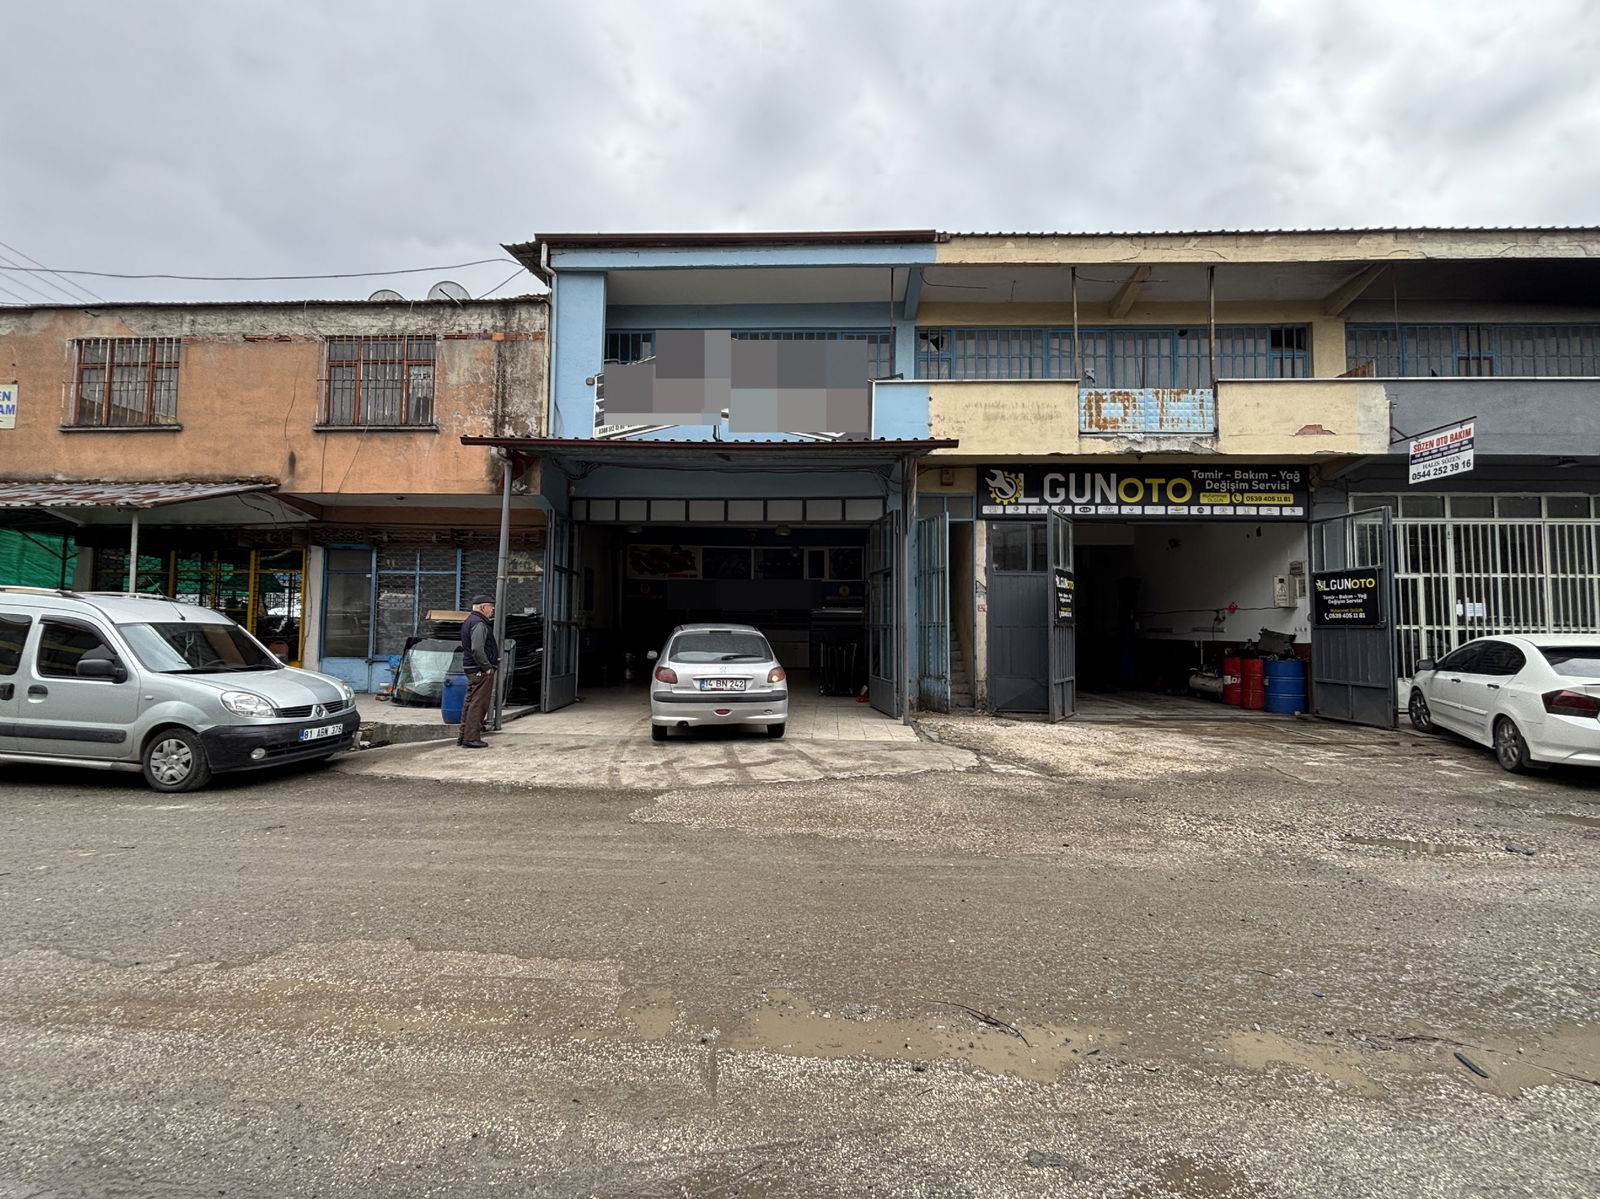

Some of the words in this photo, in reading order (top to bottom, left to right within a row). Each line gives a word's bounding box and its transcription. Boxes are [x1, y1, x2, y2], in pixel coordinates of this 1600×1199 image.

[1436, 435, 1448, 446] OTO
[1450, 428, 1472, 442] BAKIM
[1412, 470, 1431, 480] 0544
[1433, 466, 1448, 476] 252
[1450, 462, 1460, 472] 39
[1462, 458, 1472, 468] 16
[1192, 470, 1223, 480] Tamir
[1234, 470, 1268, 480] Bakım
[1280, 470, 1300, 483] Yağ
[1205, 480, 1248, 492] Değişim
[1252, 480, 1290, 490] Servisi
[730, 680, 744, 688] 242
